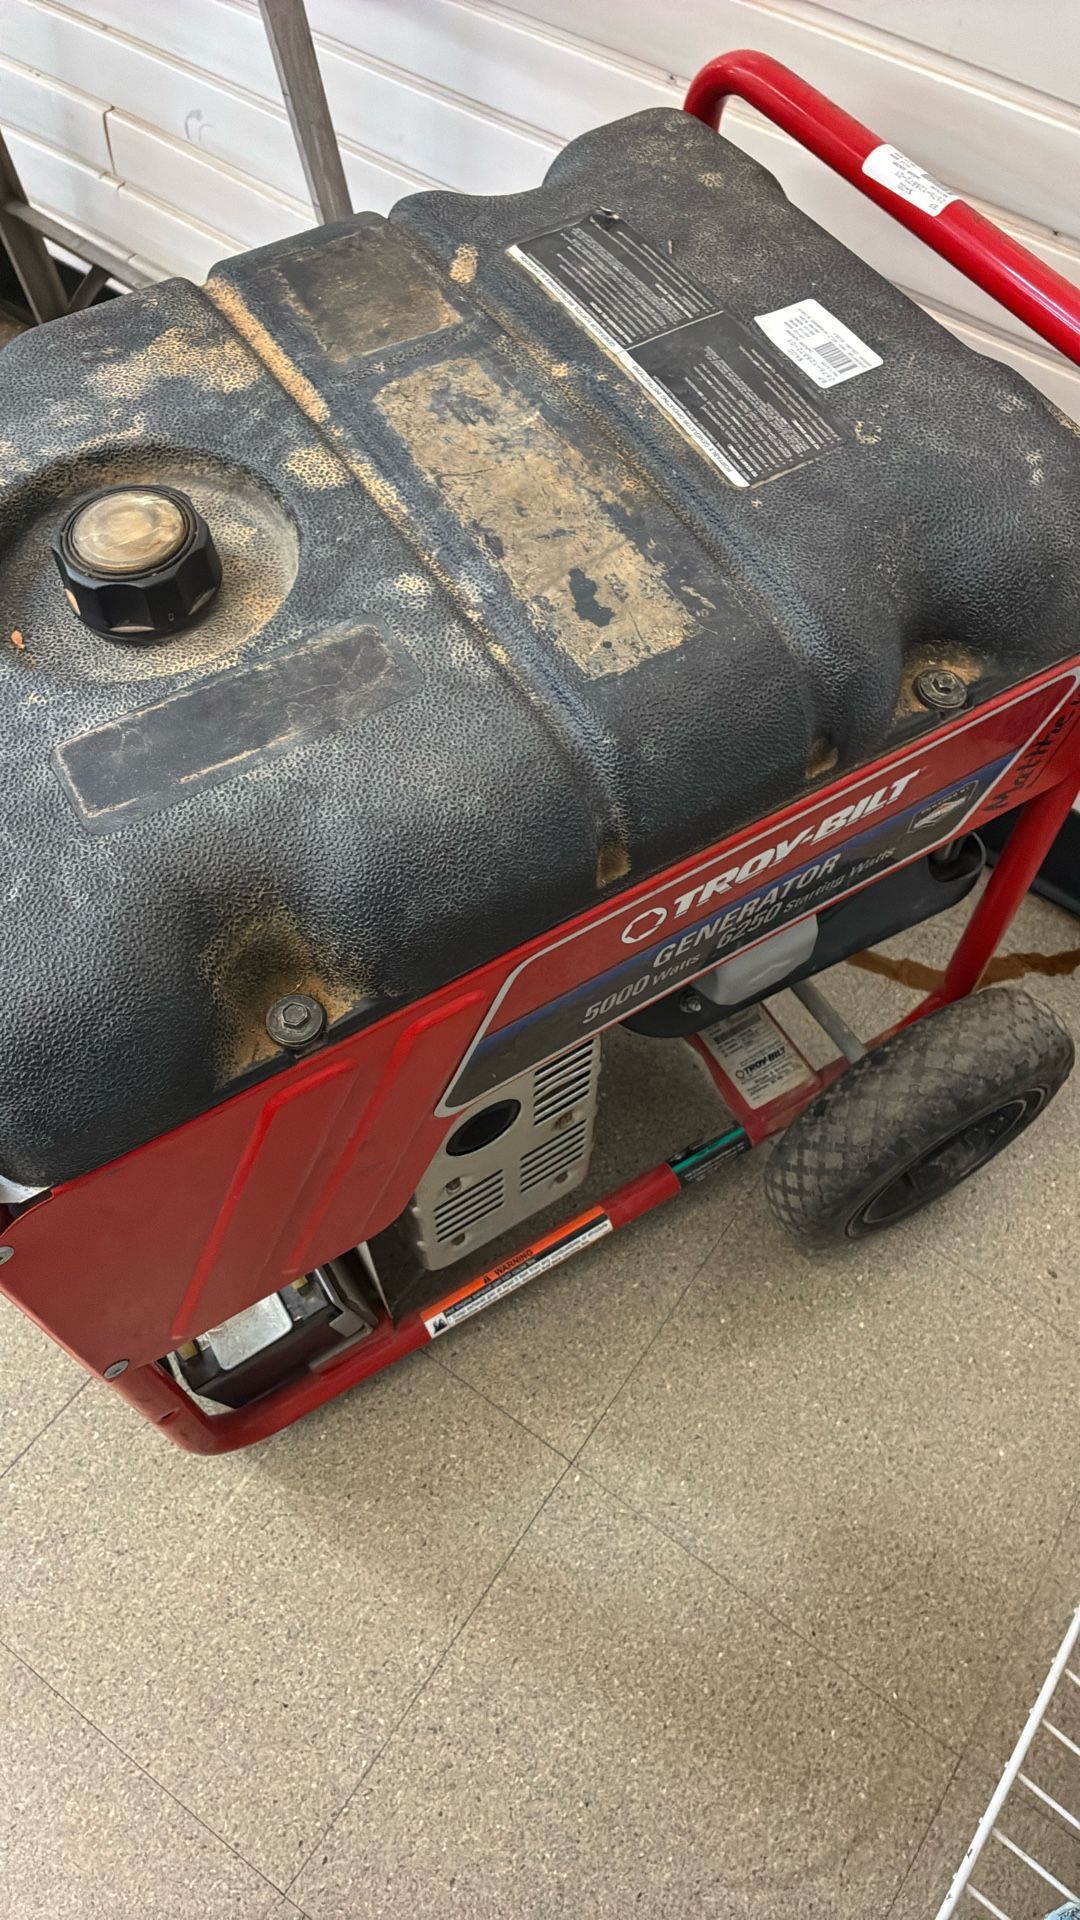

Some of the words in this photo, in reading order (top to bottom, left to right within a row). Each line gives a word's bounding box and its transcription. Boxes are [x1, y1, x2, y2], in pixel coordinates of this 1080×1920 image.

[630, 364, 662, 395] INSTRUCTIONS
[658, 394, 686, 420] OPERATING
[681, 419, 711, 447] GENERATOR
[707, 447, 734, 473] PORTABLE
[673, 767, 922, 919] TROY-BILT
[653, 854, 841, 968] GENERATOR
[582, 973, 649, 1025] 5000
[652, 952, 701, 987] Watts
[716, 901, 781, 950] 6250
[784, 874, 845, 915] Starting
[850, 845, 896, 878] Watts
[493, 1247, 534, 1277] WARNING
